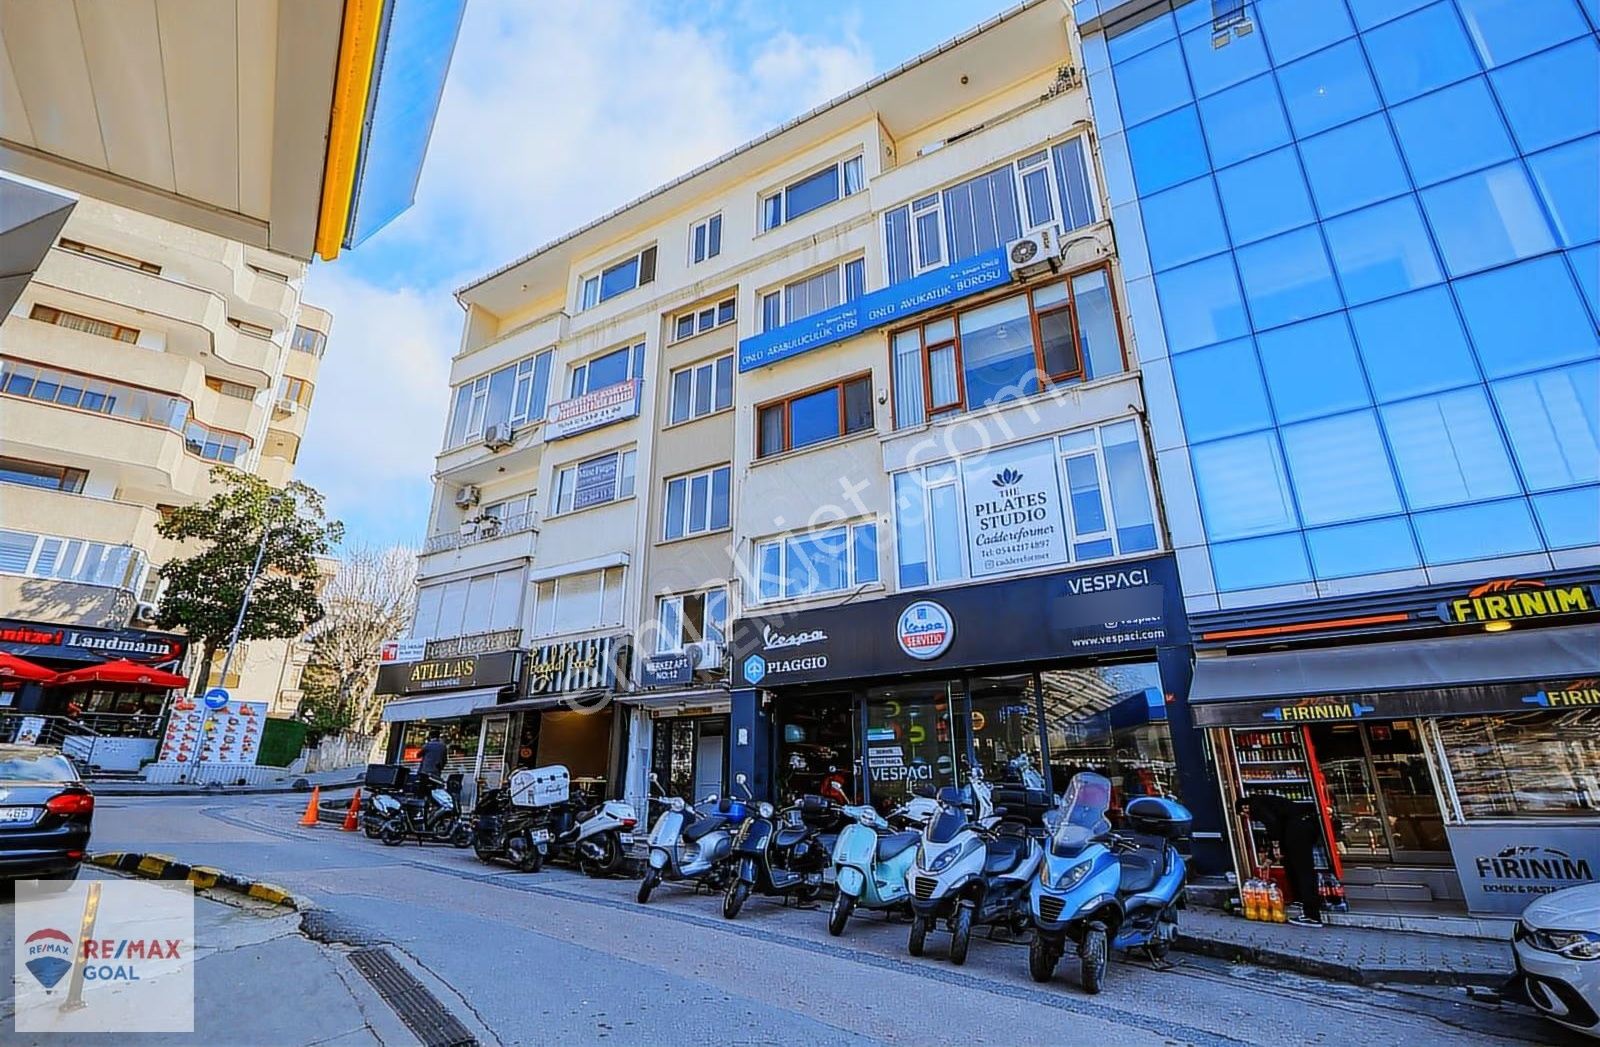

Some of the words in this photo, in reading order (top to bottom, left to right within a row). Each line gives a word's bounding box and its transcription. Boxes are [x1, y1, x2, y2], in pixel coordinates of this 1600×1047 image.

[974, 491, 1048, 517] PILATES
[980, 507, 1047, 531] STUDIO
[1067, 568, 1150, 594] VESPACI
[1453, 586, 1589, 622] FIRINIM
[904, 617, 945, 634] Vespa
[66, 632, 170, 655] Landmann
[762, 624, 828, 651] Vespa
[905, 633, 944, 648] SERVIZIO
[1071, 630, 1165, 648] www.vespaci.com
[410, 659, 475, 681] ATILLA'S
[766, 655, 828, 675] PIAGGIO
[1282, 703, 1352, 721] FIRINIM
[870, 764, 933, 781] VESPACI
[1476, 858, 1594, 880] FIRINIM
